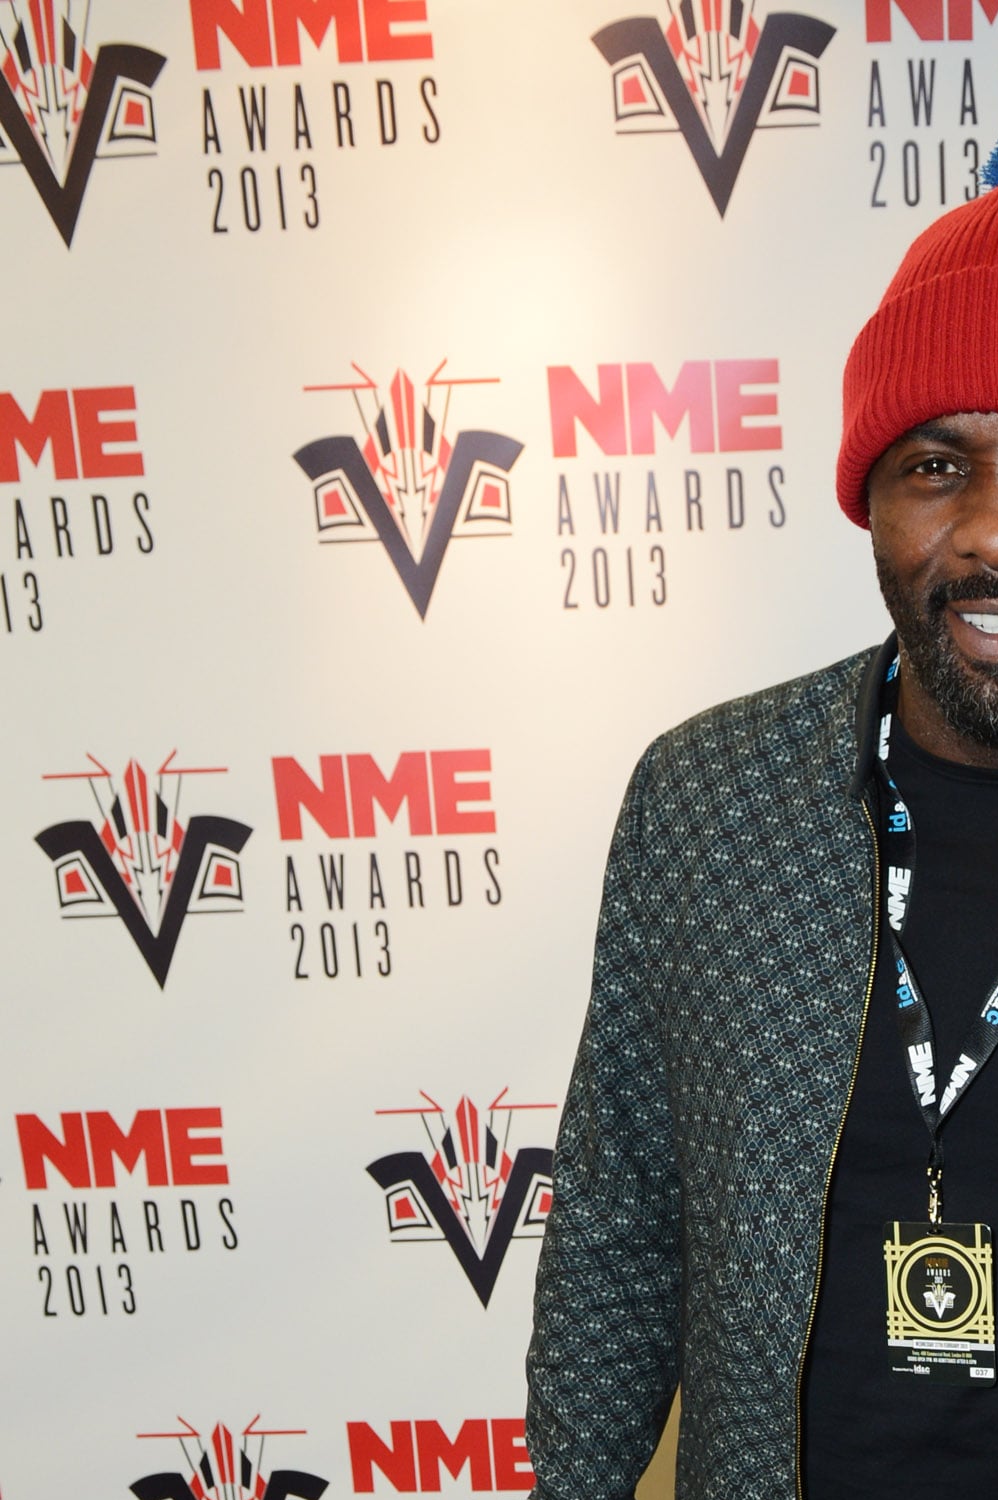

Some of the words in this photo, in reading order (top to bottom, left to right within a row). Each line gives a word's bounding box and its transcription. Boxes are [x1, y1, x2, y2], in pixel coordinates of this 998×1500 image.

[189, 0, 434, 71] NME
[203, 77, 441, 154] AWARDS
[208, 164, 320, 233] 2013
[870, 139, 979, 207] 2013
[0, 386, 144, 483] ME
[547, 358, 783, 458] NME
[15, 492, 153, 559] ARDS
[557, 466, 786, 536] AWARDS
[0, 571, 42, 632] 13
[561, 546, 667, 609] 2013
[272, 749, 497, 840] NME
[286, 848, 501, 912] AWARDS
[888, 866, 911, 931] NME
[290, 922, 392, 979] 2013
[908, 1041, 936, 1107] NME
[15, 1107, 229, 1190] NME
[33, 1198, 239, 1256] AWARDS
[38, 1264, 136, 1317] 2013
[346, 1419, 537, 1493] NME
